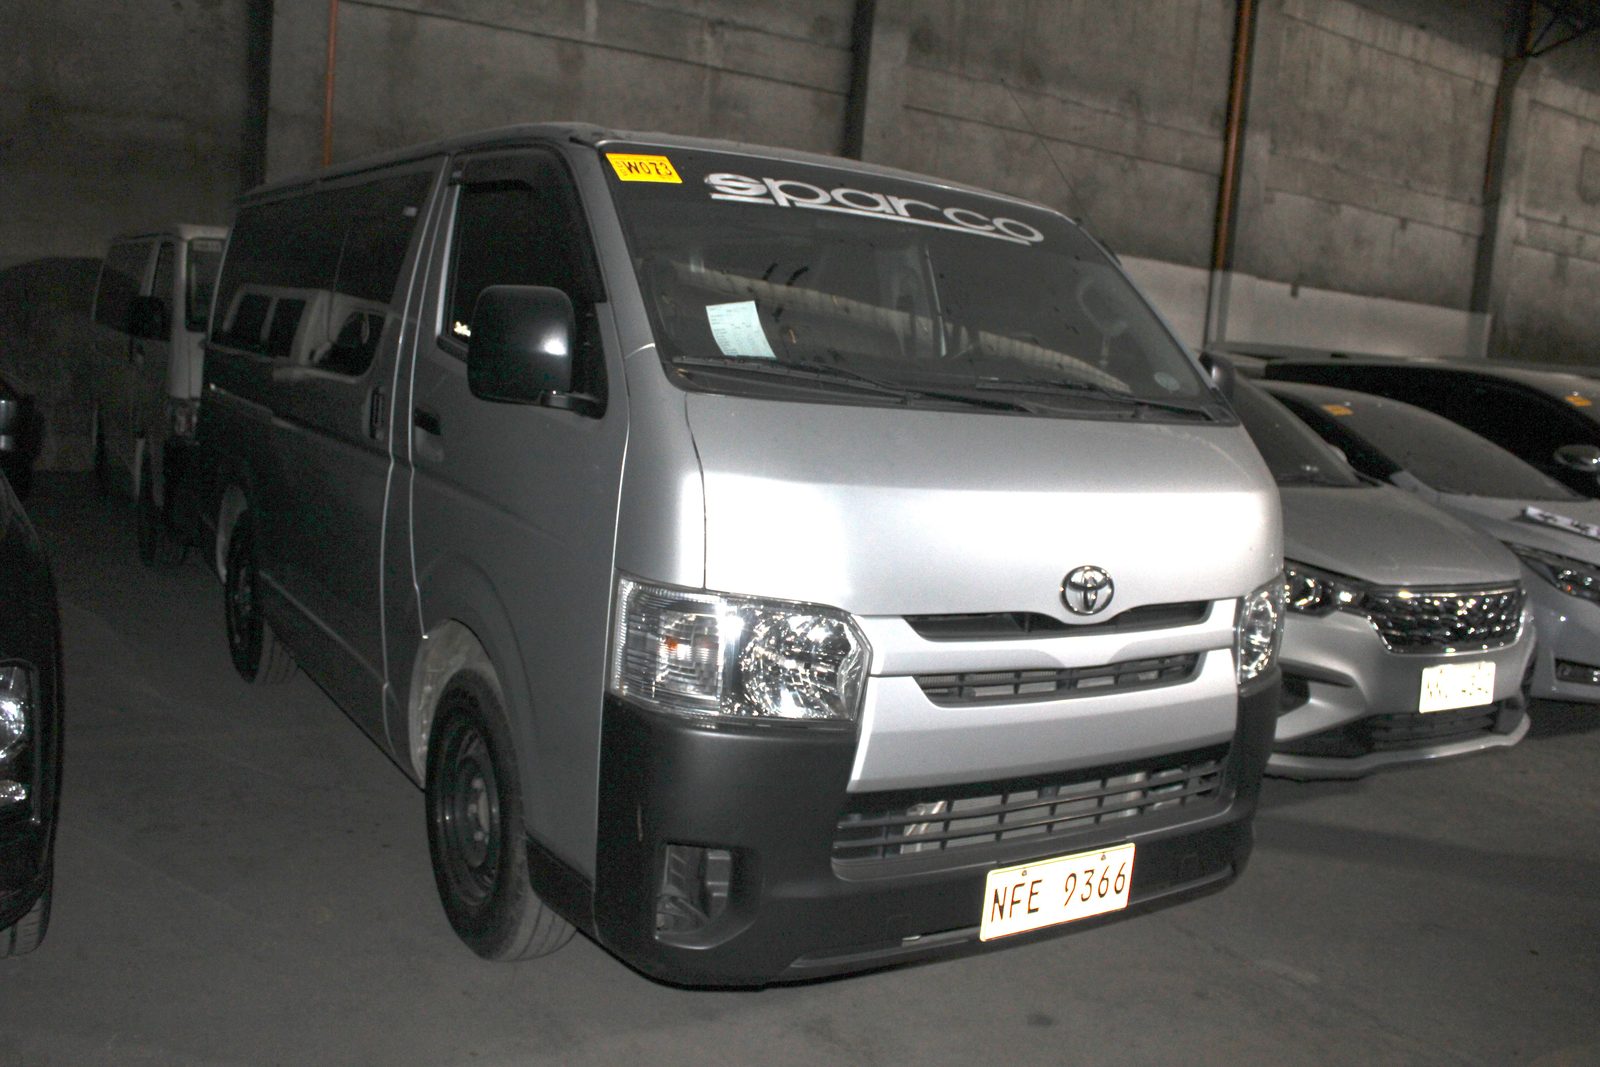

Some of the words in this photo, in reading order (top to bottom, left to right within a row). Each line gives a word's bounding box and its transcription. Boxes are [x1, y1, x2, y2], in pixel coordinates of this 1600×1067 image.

[622, 161, 672, 176] W073
[704, 172, 1045, 245] sparco
[991, 879, 1043, 922] NFE
[1064, 862, 1126, 907] 9366
